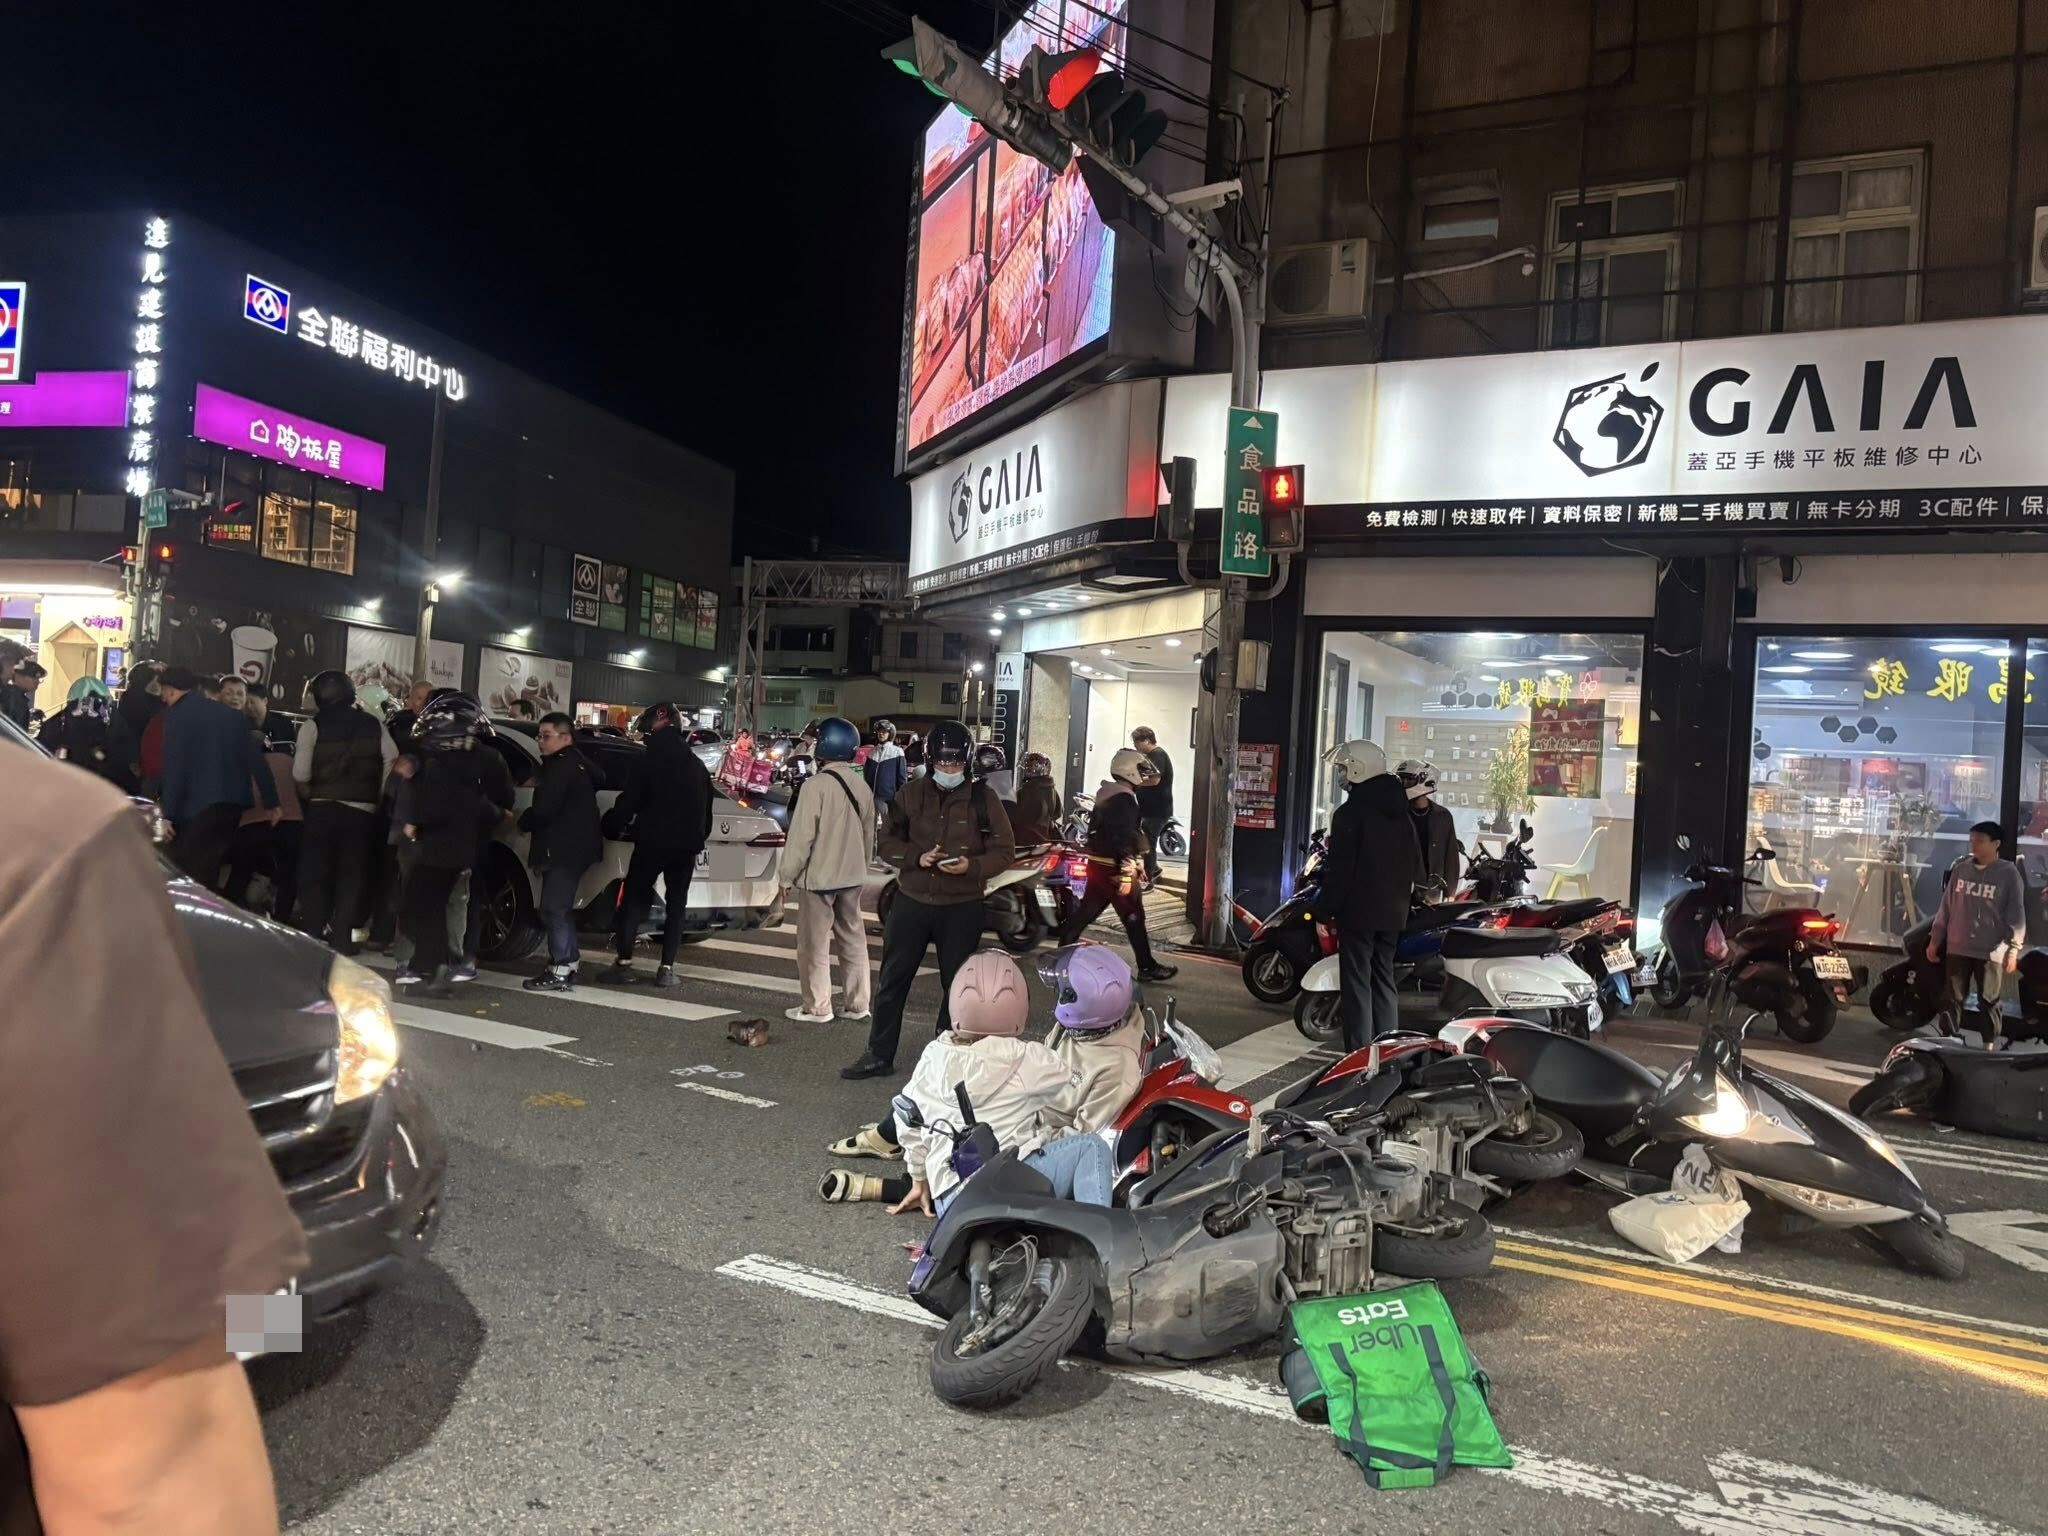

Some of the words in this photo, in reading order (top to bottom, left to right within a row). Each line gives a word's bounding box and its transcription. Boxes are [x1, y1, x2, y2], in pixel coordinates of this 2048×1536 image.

[297, 307, 465, 400] 全聯福利中心
[1689, 356, 1977, 437] GAIA
[276, 424, 342, 469] 陶板屋
[1687, 444, 1983, 471] 蓋亞手機平板維修中心
[978, 445, 1043, 514] GAIA
[1233, 443, 1264, 560] 食品路
[1366, 509, 1437, 527] 免費檢測
[1452, 506, 1527, 526] 快速取件
[1543, 504, 1622, 524] 資料保密
[1637, 501, 1789, 522] 新機二手機買賣
[1807, 498, 1900, 519] 無卡分期
[1918, 496, 1999, 517] 3C配件
[2021, 496, 2048, 516] 保
[575, 599, 596, 617] 全聯
[1955, 879, 1996, 899] PYJH
[1337, 1299, 1409, 1325] Eats
[1350, 1322, 1420, 1355] Uber
